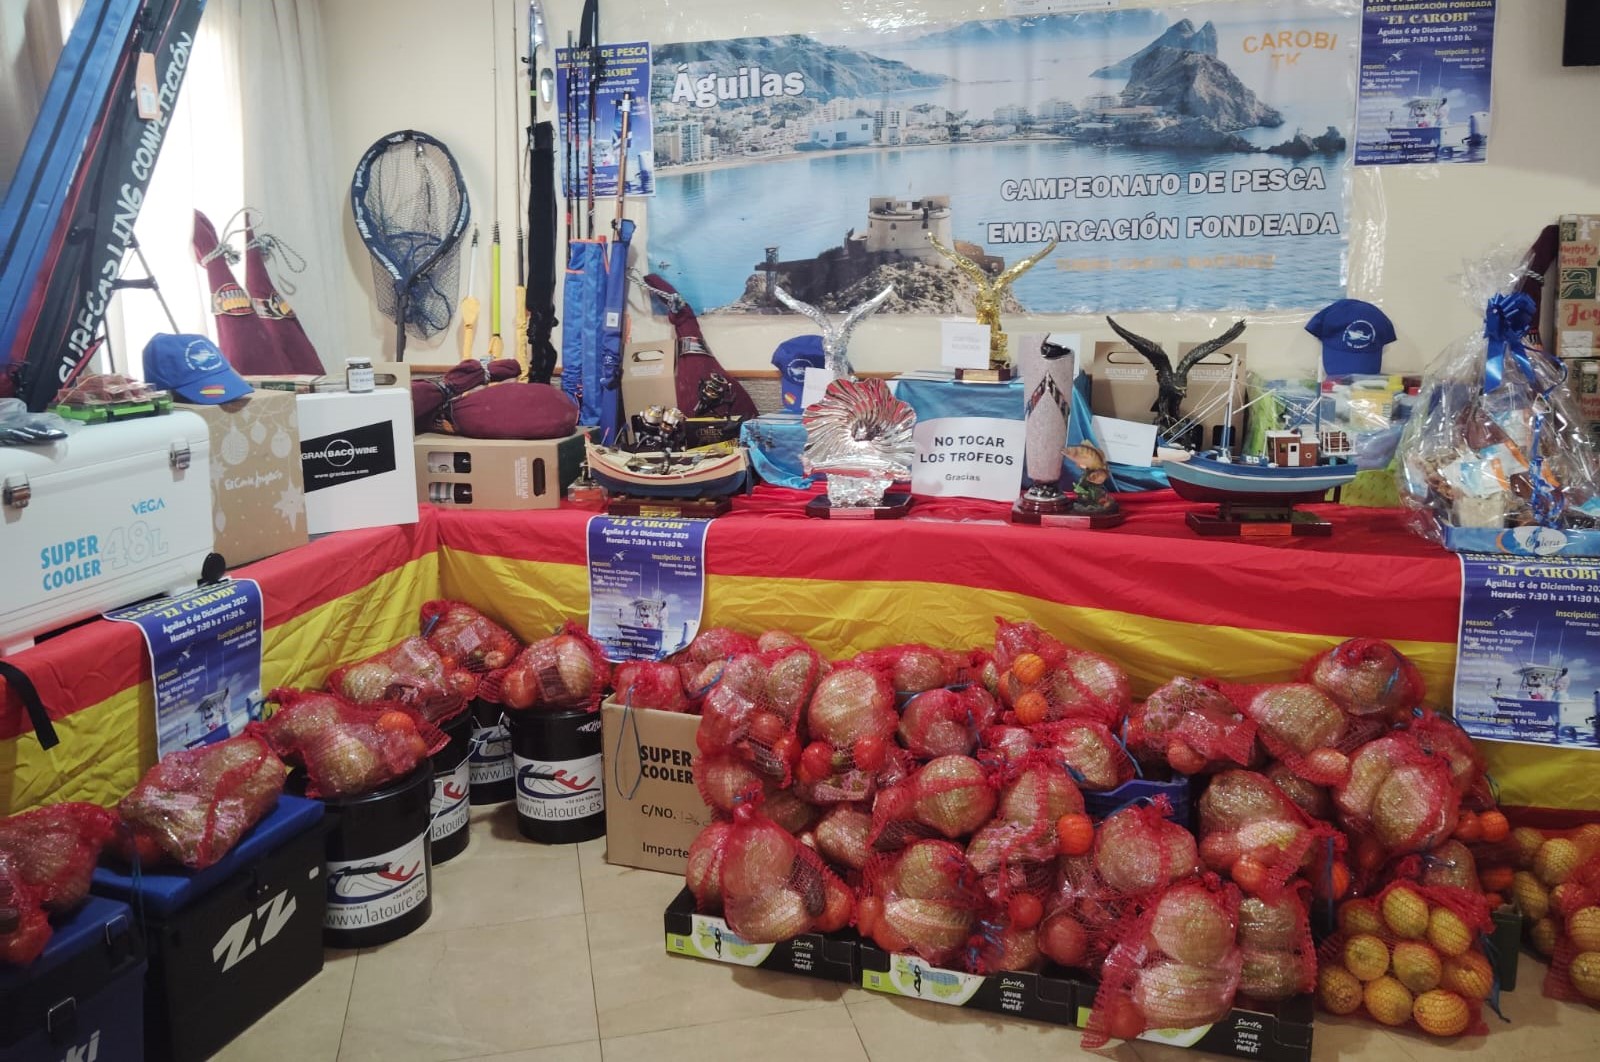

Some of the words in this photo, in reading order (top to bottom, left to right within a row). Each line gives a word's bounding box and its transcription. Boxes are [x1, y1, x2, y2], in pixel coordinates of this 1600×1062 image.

[1242, 30, 1338, 54] CAROBI
[617, 46, 648, 57] PESCA
[671, 63, 805, 108] Águilas
[1000, 173, 1181, 202] CAMPEONATO
[1188, 171, 1226, 194] DE
[1232, 167, 1326, 192] PESCA
[987, 212, 1179, 244] EMBARCACIÓN
[1186, 212, 1339, 239] FONDEADA
[934, 436, 954, 447] NO
[958, 435, 1005, 448] TOCAR
[301, 452, 326, 460] GRAN
[354, 446, 378, 455] WINE
[920, 453, 945, 463] LOS
[949, 451, 1014, 466] TROFEOS
[945, 473, 981, 482] Gracias
[132, 498, 165, 515] VEGA
[630, 528, 639, 536] de
[40, 535, 99, 570] SUPER
[43, 559, 102, 592] COOLER
[1518, 581, 1525, 589] 6
[1527, 581, 1538, 589] de
[1540, 582, 1585, 592] Diciembre
[1491, 590, 1526, 599] Horario:
[1528, 592, 1549, 600] 7:30
[1550, 592, 1556, 600] h
[1566, 594, 1592, 603] 11:30
[193, 613, 202, 621] de
[201, 602, 232, 619] Diciembre
[231, 595, 248, 607] 2025
[1555, 610, 1599, 620] Inscripción:
[640, 745, 693, 767] SUPER
[470, 765, 512, 782] www.la
[641, 765, 693, 784] COOLER
[518, 800, 601, 818] www.latoure.es
[641, 804, 677, 820] C/NO.
[431, 811, 469, 839] latoure.
[642, 841, 690, 859] Importe
